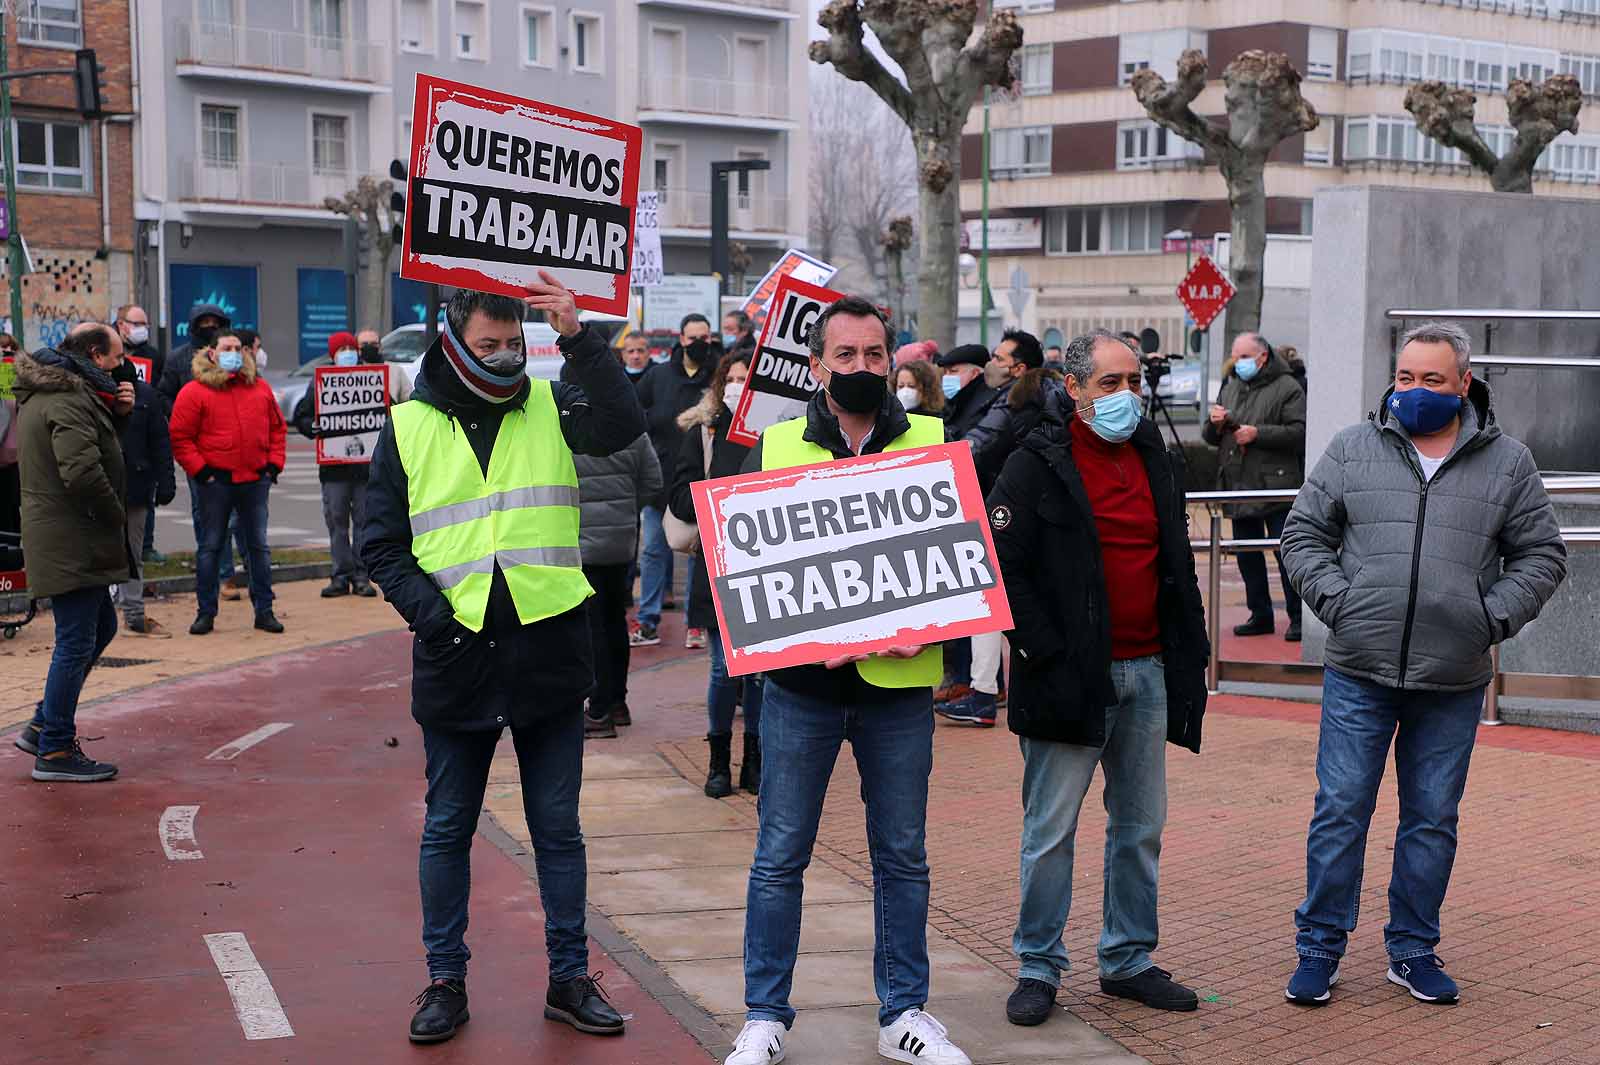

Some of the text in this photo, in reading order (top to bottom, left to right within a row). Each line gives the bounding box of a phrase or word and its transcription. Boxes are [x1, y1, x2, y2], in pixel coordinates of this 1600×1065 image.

[435, 119, 621, 197] QUEREMOS
[422, 183, 628, 271] TRABAJAR
[777, 295, 821, 346] IG
[321, 389, 384, 405] CASADO
[755, 352, 819, 392] DIMIS
[320, 411, 386, 431] DIMISIÓN
[726, 480, 958, 558] QUEREMOS
[727, 539, 993, 625] TRABAJAR
